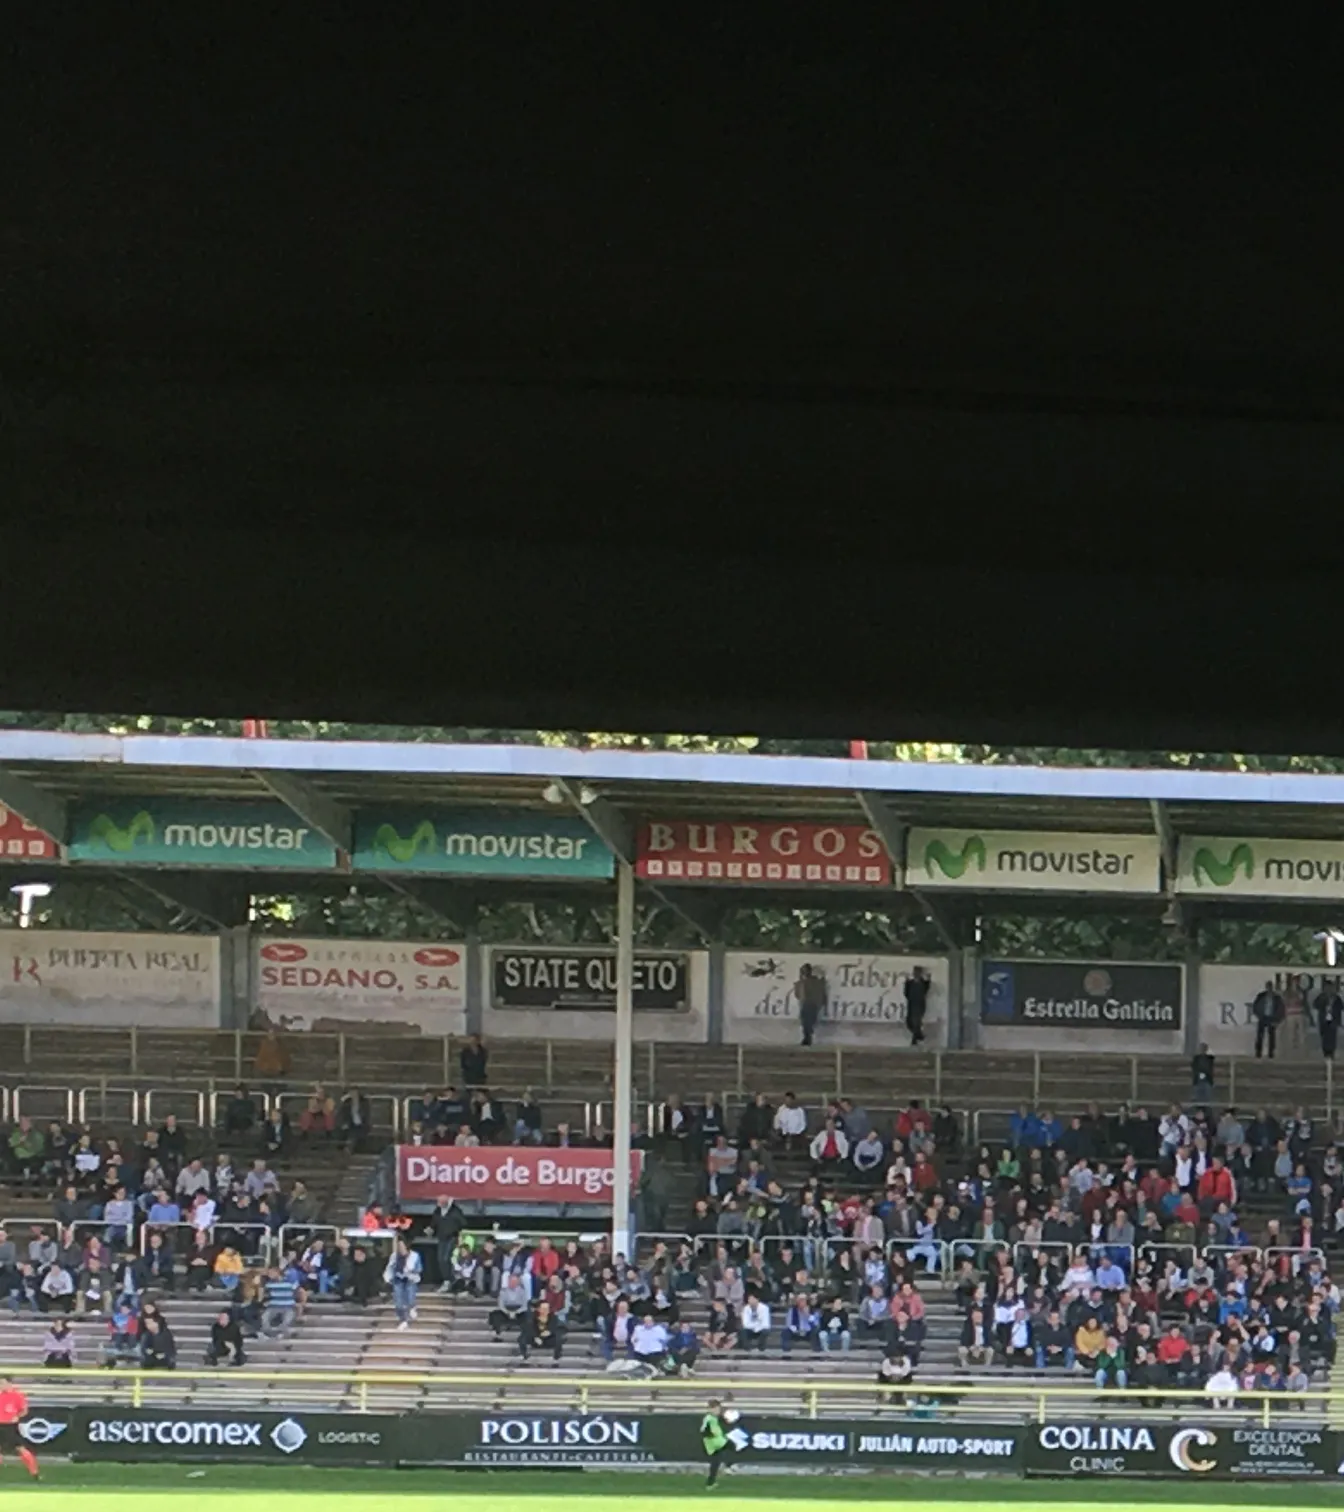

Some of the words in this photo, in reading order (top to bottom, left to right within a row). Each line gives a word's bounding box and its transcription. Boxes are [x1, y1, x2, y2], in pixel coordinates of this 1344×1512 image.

[164, 822, 308, 851] movistar
[445, 831, 588, 861] movistar
[647, 822, 884, 859] BURGOS
[997, 847, 1135, 876] movistar
[504, 957, 579, 990] STATE
[585, 959, 677, 993] QUETO
[1023, 997, 1099, 1021] Estrella
[1102, 1000, 1174, 1022] Galicia
[406, 1156, 490, 1184] Diario
[495, 1156, 530, 1184] de
[537, 1159, 633, 1194] Burgo
[88, 1418, 262, 1447] asercomex
[480, 1415, 641, 1444] POLISÓN
[751, 1431, 845, 1451] SUZUKI
[857, 1432, 913, 1454] JULIÁN
[916, 1436, 1015, 1457] AUTO-SPORT
[1039, 1425, 1156, 1452] COLINA
[1069, 1455, 1126, 1473] CLINIC
